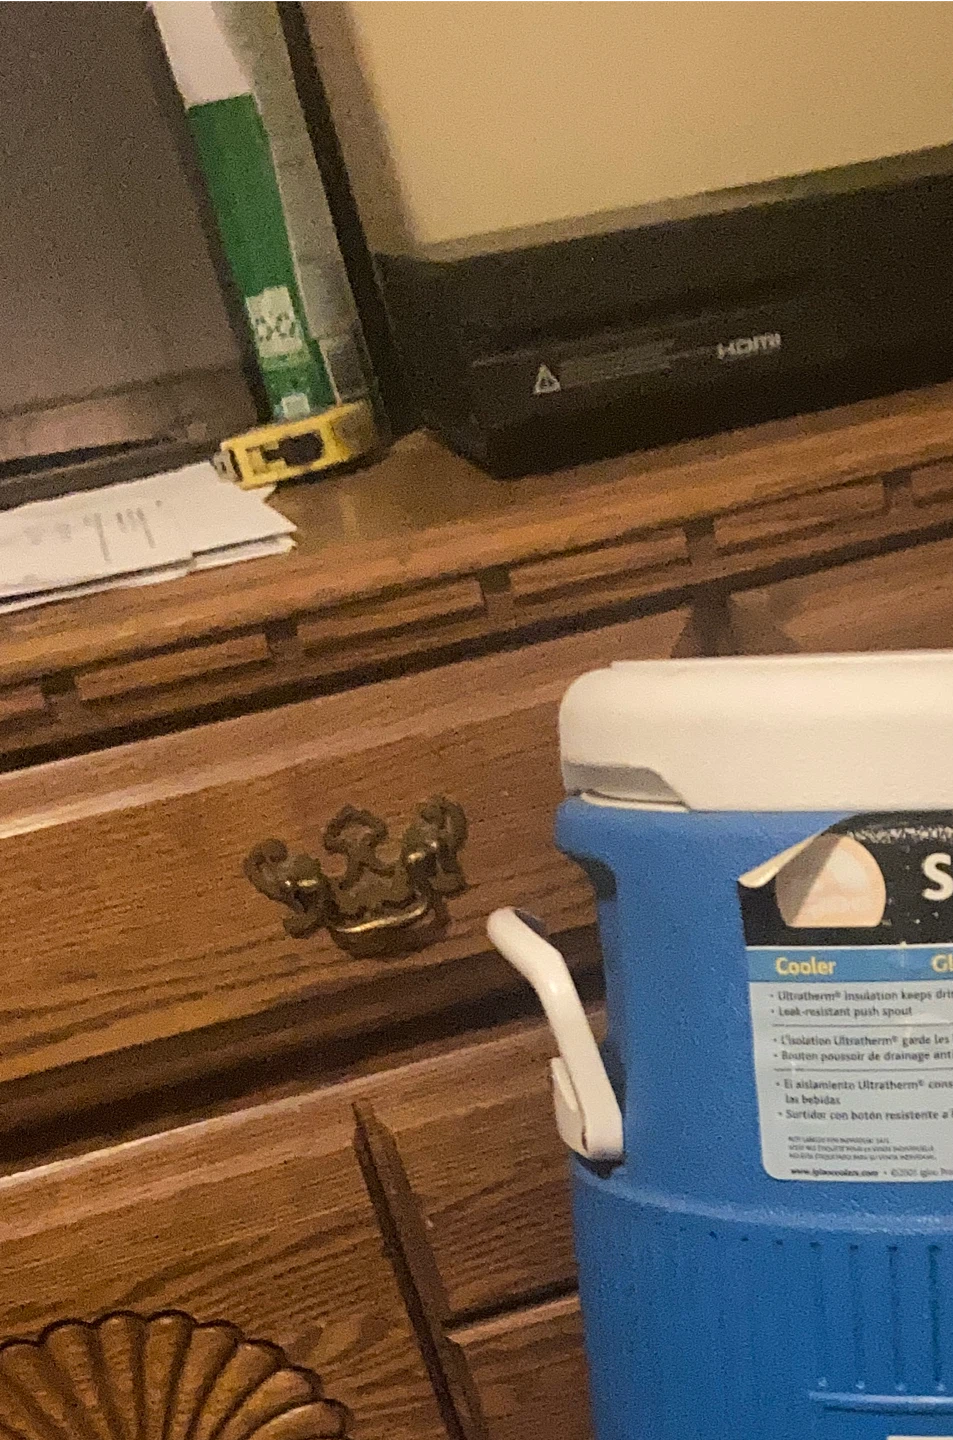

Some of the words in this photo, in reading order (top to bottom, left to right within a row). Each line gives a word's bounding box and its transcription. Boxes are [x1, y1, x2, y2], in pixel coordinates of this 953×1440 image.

[775, 956, 837, 976] Cooler
[901, 990, 932, 1004] keeps
[778, 1006, 850, 1017] Leak-resistant
[854, 1006, 879, 1018] push
[882, 1006, 913, 1018] spout
[902, 1035, 930, 1048] garde
[934, 1034, 950, 1044] les
[820, 1051, 865, 1064] poussoir
[868, 1051, 881, 1061] de
[883, 1051, 930, 1064] drainage
[796, 1079, 855, 1090] aislamiento
[801, 1095, 841, 1105] bebidas
[786, 1110, 826, 1119] Surtidor
[830, 1111, 848, 1120] con
[885, 1110, 939, 1120] resistente
